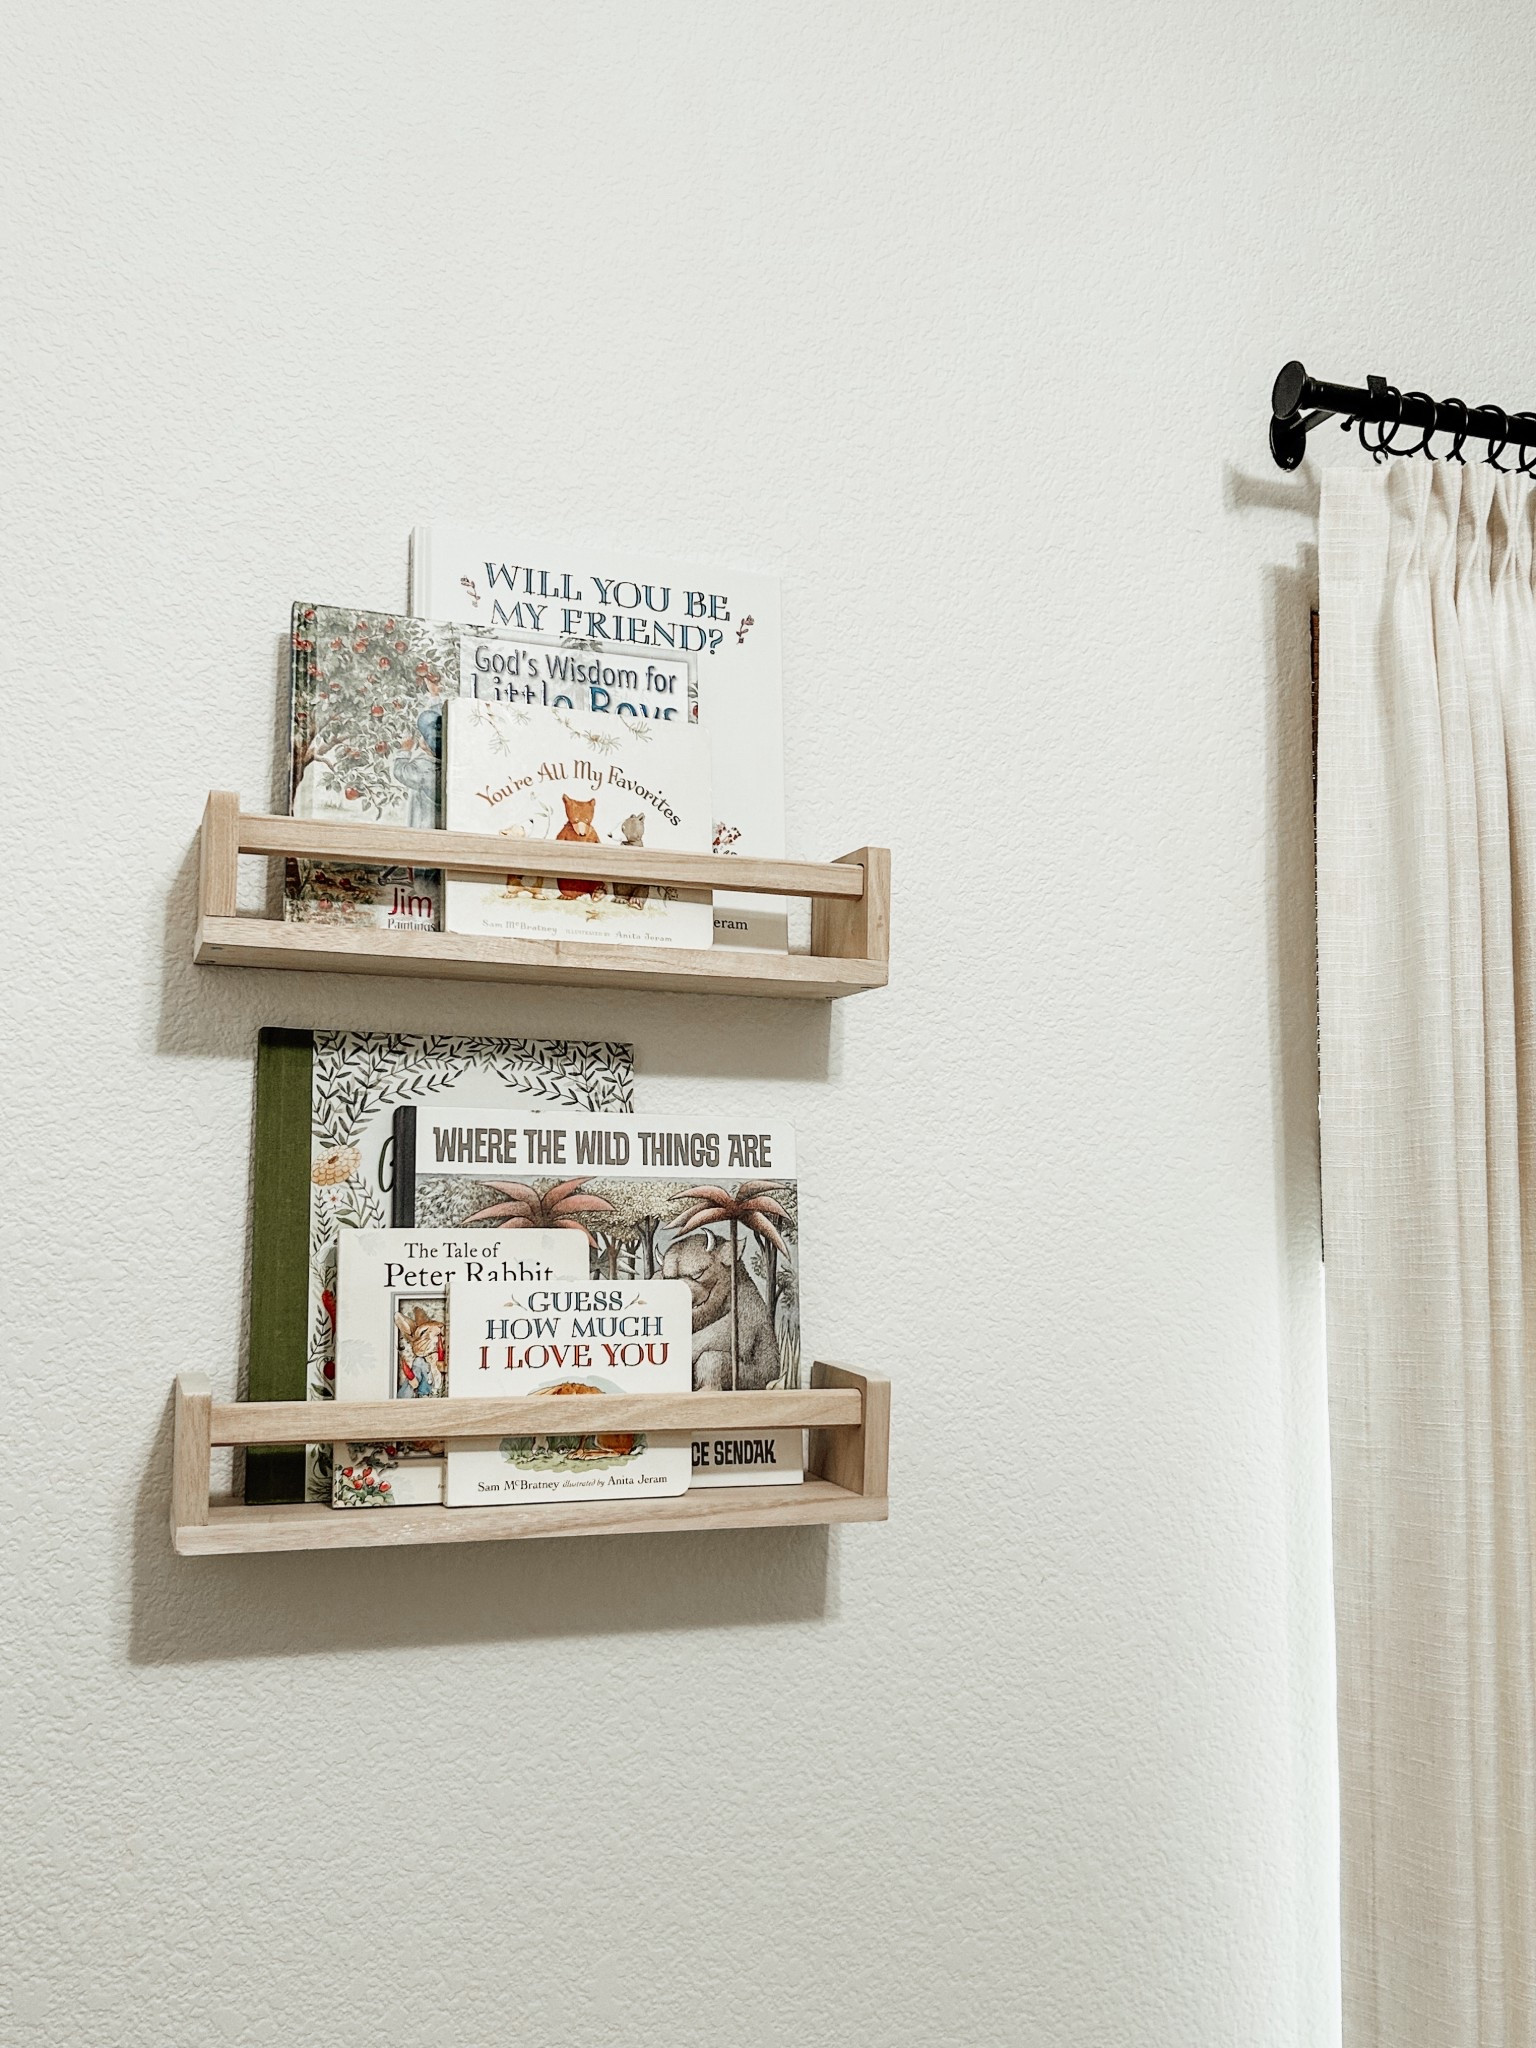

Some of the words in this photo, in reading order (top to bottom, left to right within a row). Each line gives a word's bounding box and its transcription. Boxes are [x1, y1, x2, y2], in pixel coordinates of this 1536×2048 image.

[484, 562, 582, 601] WILL
[590, 575, 671, 613] YOU
[683, 590, 731, 621] BE
[490, 599, 548, 631] MY
[561, 607, 724, 655] FRIEND?
[474, 645, 539, 677] God's
[545, 654, 638, 689] Wisdom
[645, 665, 678, 694] for
[470, 673, 574, 710] Little
[475, 775, 533, 808] You're
[537, 762, 568, 783] All
[574, 759, 603, 791] My
[607, 765, 682, 827] Favorites
[387, 887, 433, 918] Jim
[482, 919, 503, 929] Sam
[615, 930, 641, 940] Anita
[643, 933, 673, 942] Jeram
[433, 1127, 517, 1164] WHERE
[523, 1129, 567, 1165] THE
[575, 1130, 630, 1166] WILD
[637, 1132, 720, 1168] THINGS
[728, 1134, 772, 1168] ARE
[404, 1242, 438, 1258] The
[442, 1242, 477, 1258] Tale
[481, 1242, 501, 1258] of
[384, 1262, 456, 1288] Peter
[466, 1262, 554, 1282] Rabbit
[527, 1291, 624, 1313] GUESS
[485, 1317, 559, 1340] HOW
[571, 1316, 664, 1338] MUCH
[478, 1346, 490, 1370] I
[504, 1344, 592, 1370] LOVE
[601, 1343, 670, 1367] YOU
[713, 1439, 777, 1466] SENDAK
[477, 1481, 500, 1492] Sam
[503, 1479, 560, 1491] McBratney
[607, 1475, 634, 1486] Anita
[637, 1474, 668, 1485] Jeram
